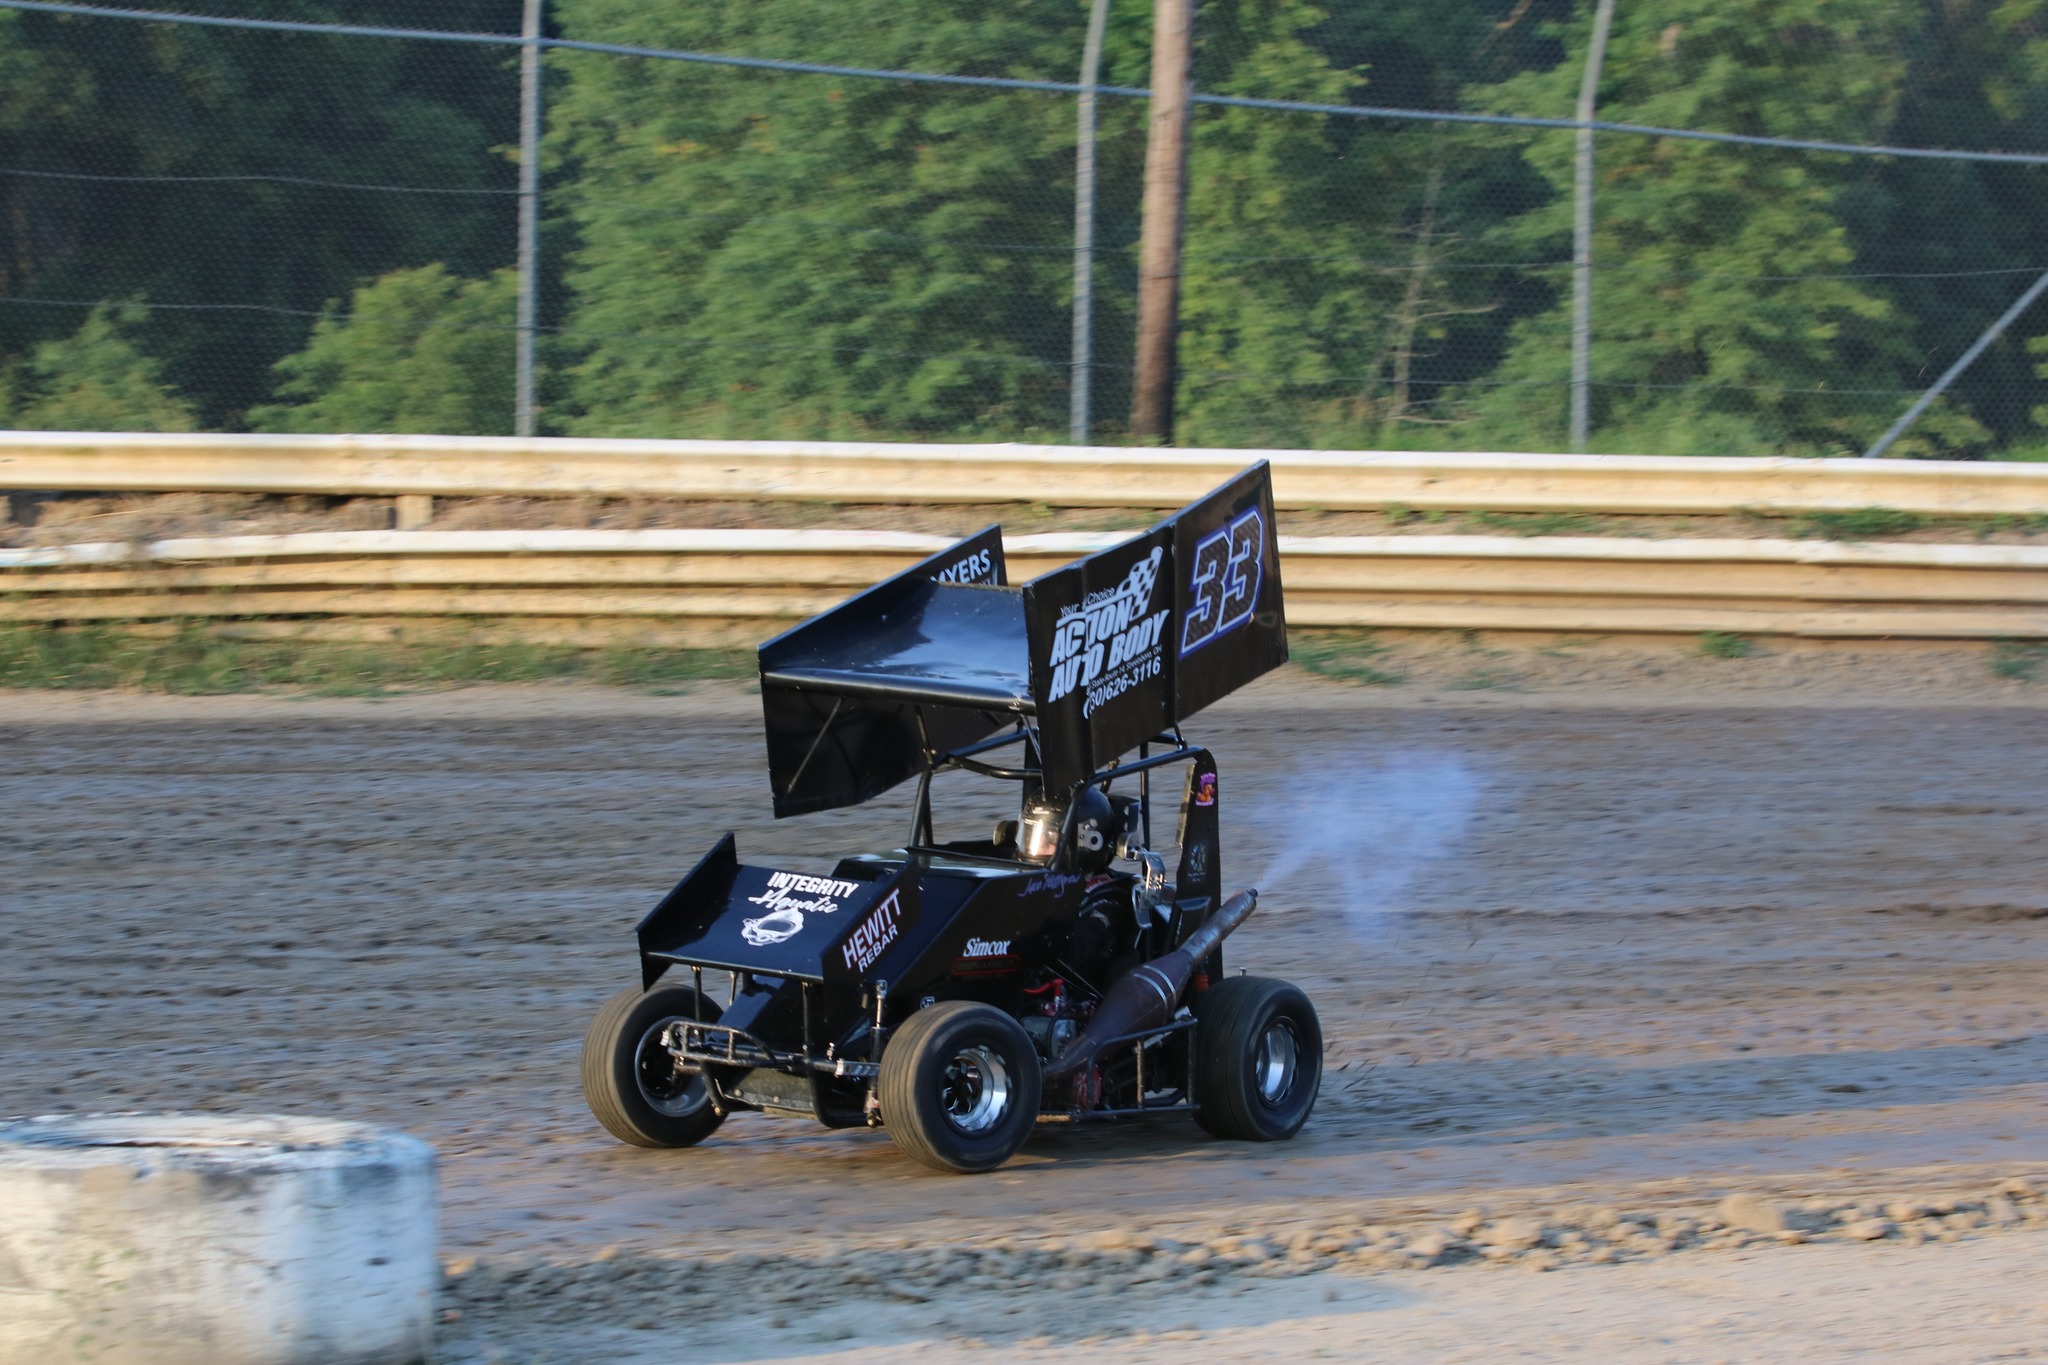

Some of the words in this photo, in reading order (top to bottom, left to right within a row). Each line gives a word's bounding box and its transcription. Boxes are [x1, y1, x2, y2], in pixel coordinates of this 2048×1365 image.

[1180, 505, 1264, 658] 33
[1048, 643, 1105, 703] AUTO
[1107, 609, 1170, 671] BODY
[1049, 596, 1133, 667] ACTION
[767, 871, 859, 898] INTEGRITY
[842, 888, 901, 969] HEWITT
[858, 924, 898, 973] REBAR
[963, 937, 1011, 957] Simcox
